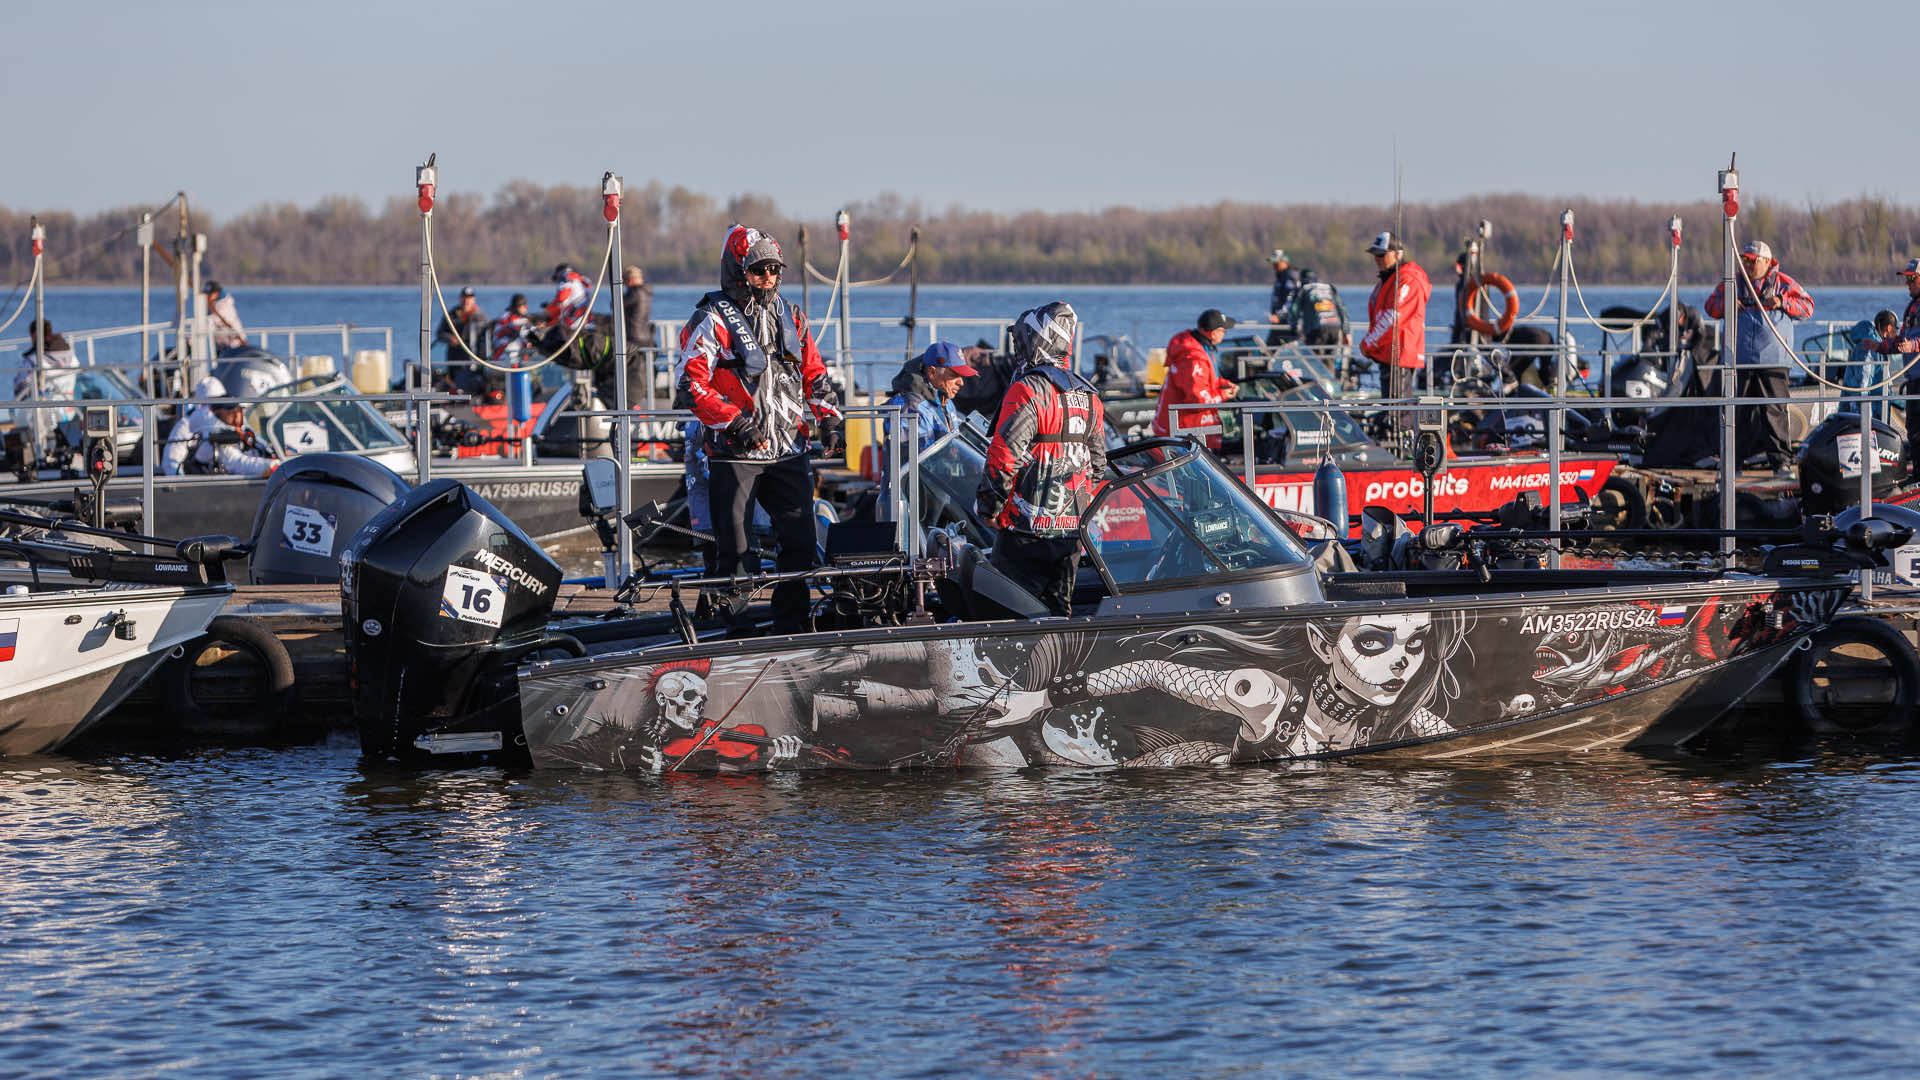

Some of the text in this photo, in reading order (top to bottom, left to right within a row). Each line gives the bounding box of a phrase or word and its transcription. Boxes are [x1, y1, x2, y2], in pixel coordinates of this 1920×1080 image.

[717, 300, 757, 351] SEA-PRO
[1490, 470, 1578, 490] MA4162RS50
[292, 520, 322, 544] 33
[155, 564, 189, 572] LOWRANCE
[474, 548, 548, 596] MERCURY
[462, 584, 492, 614] 16
[1520, 609, 1656, 635] AM3522RUS64
